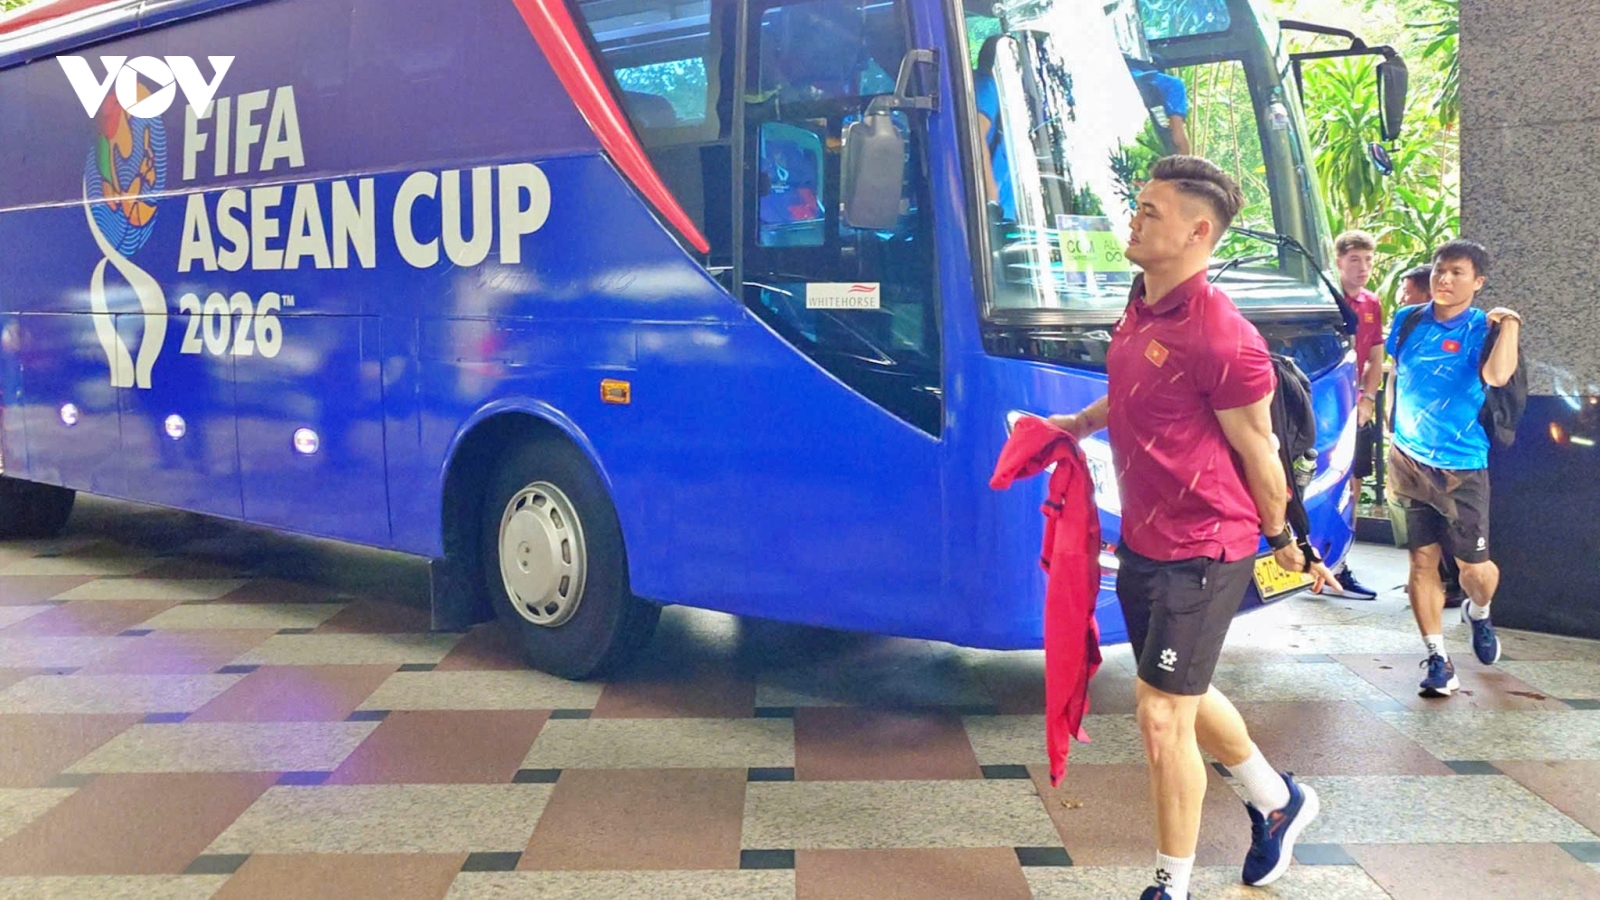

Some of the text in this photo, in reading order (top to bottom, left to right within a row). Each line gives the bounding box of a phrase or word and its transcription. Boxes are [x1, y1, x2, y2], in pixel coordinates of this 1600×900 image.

[182, 85, 305, 181] FIFA
[177, 162, 551, 273] ASEAN CUP
[808, 296, 876, 308] WHITEHORSE
